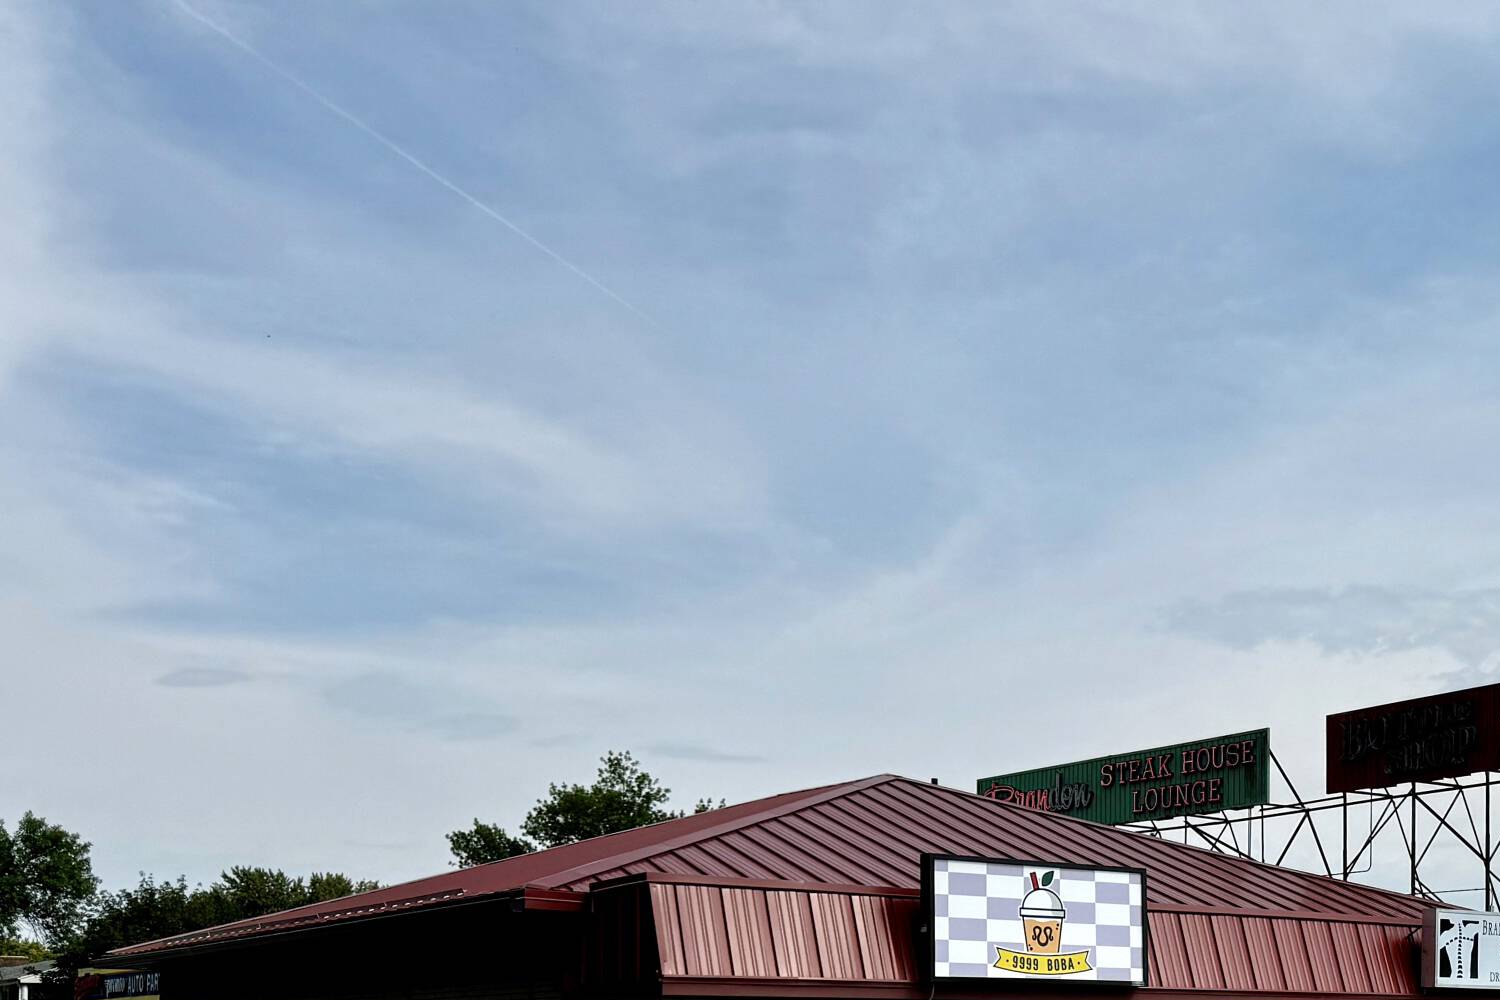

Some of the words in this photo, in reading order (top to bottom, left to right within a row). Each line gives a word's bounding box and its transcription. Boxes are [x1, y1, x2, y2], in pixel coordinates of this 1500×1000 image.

[1100, 753, 1173, 787] STEAK
[1180, 739, 1257, 774] HOUSE
[1132, 777, 1222, 813] LOUNGE
[1012, 955, 1039, 971] 9999
[1047, 957, 1075, 972] BOBA
[127, 974, 144, 993] AUTO
